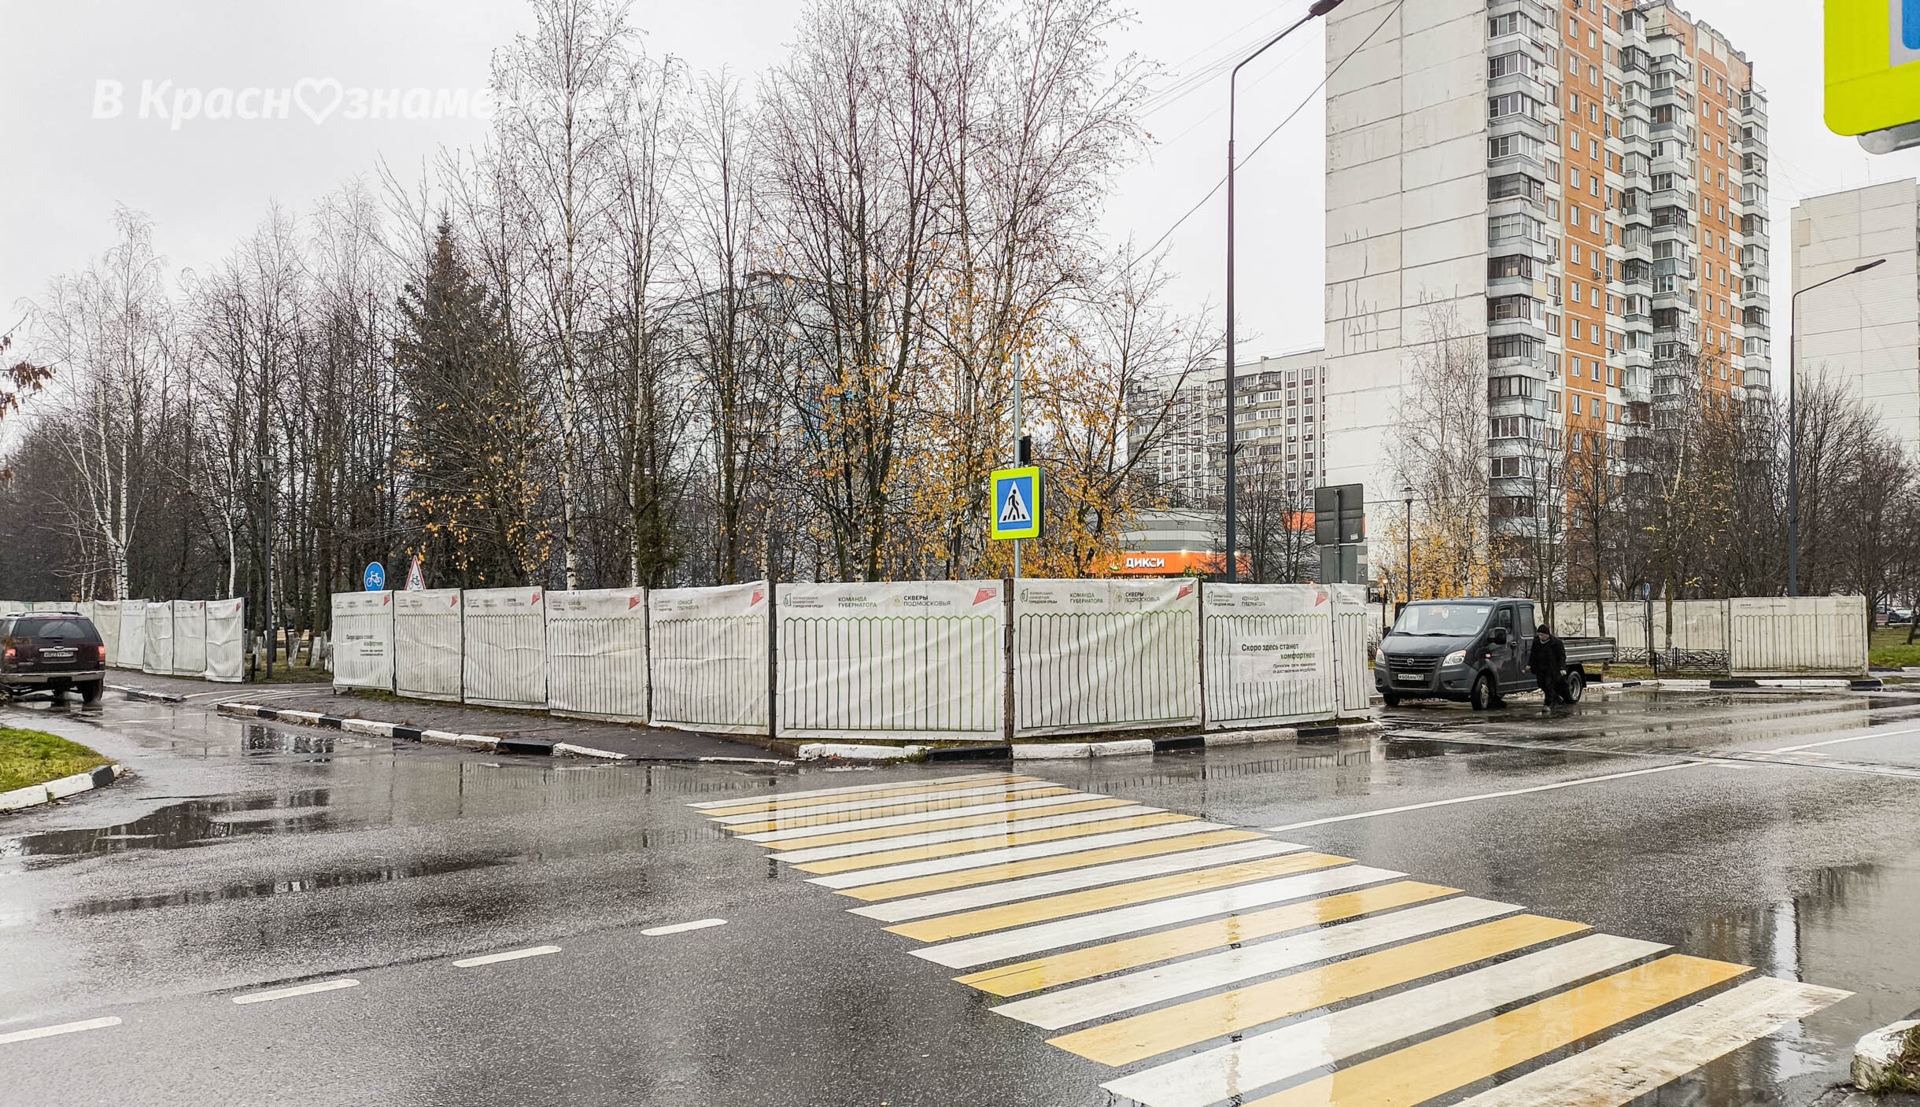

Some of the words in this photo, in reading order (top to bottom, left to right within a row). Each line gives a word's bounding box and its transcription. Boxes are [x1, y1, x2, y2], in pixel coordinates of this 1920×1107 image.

[1125, 557, 1165, 569] ДИКСИ
[1241, 643, 1262, 652] Скоро
[1262, 644, 1279, 652] здесь
[1280, 650, 1316, 660] комфортнее
